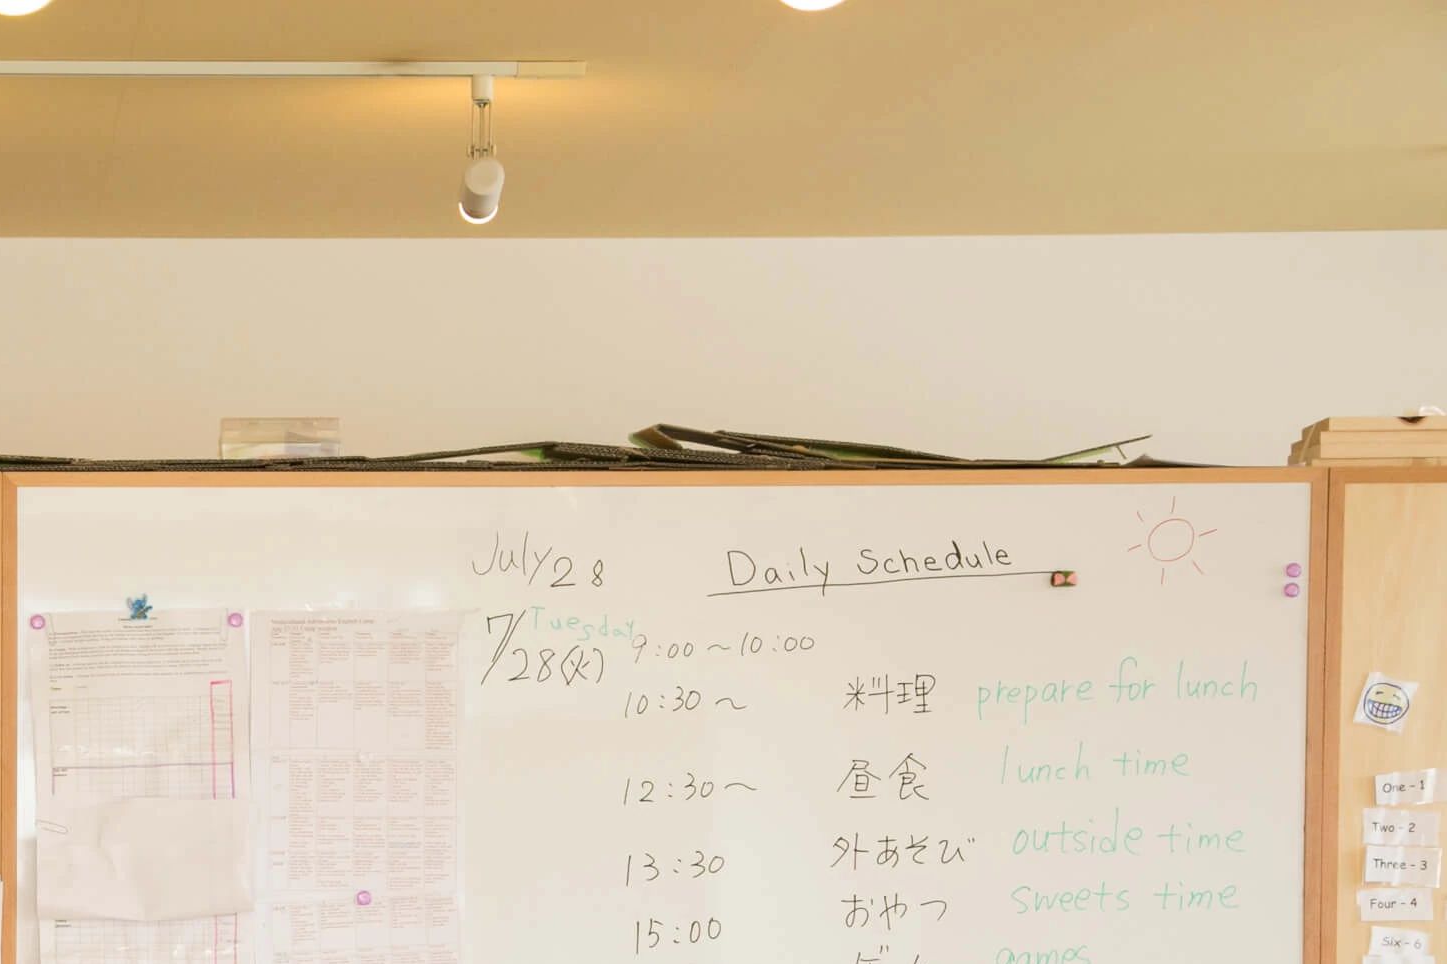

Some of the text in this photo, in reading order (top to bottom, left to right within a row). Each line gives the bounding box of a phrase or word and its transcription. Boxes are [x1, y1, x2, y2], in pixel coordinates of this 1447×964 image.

[472, 530, 605, 588] July 28
[727, 538, 1013, 597] Daily Schedule
[529, 605, 635, 641] Tuesday
[843, 673, 937, 715] 料理
[976, 655, 1259, 726] prepare for lunch
[837, 752, 930, 801] 昼食
[999, 741, 1191, 785] lunch time
[1382, 779, 1426, 794] One 1
[1011, 807, 1248, 856] outside time
[1372, 821, 1416, 833] Two 2
[625, 850, 726, 888] 13:30
[830, 832, 976, 871] 外あそび
[1373, 857, 1428, 871] Three 3
[840, 893, 949, 930] おやつ
[1151, 879, 1242, 912] time
[1369, 897, 1418, 910] Four 4
[634, 917, 722, 956] 15:00
[1382, 936, 1422, 950] Six 6
